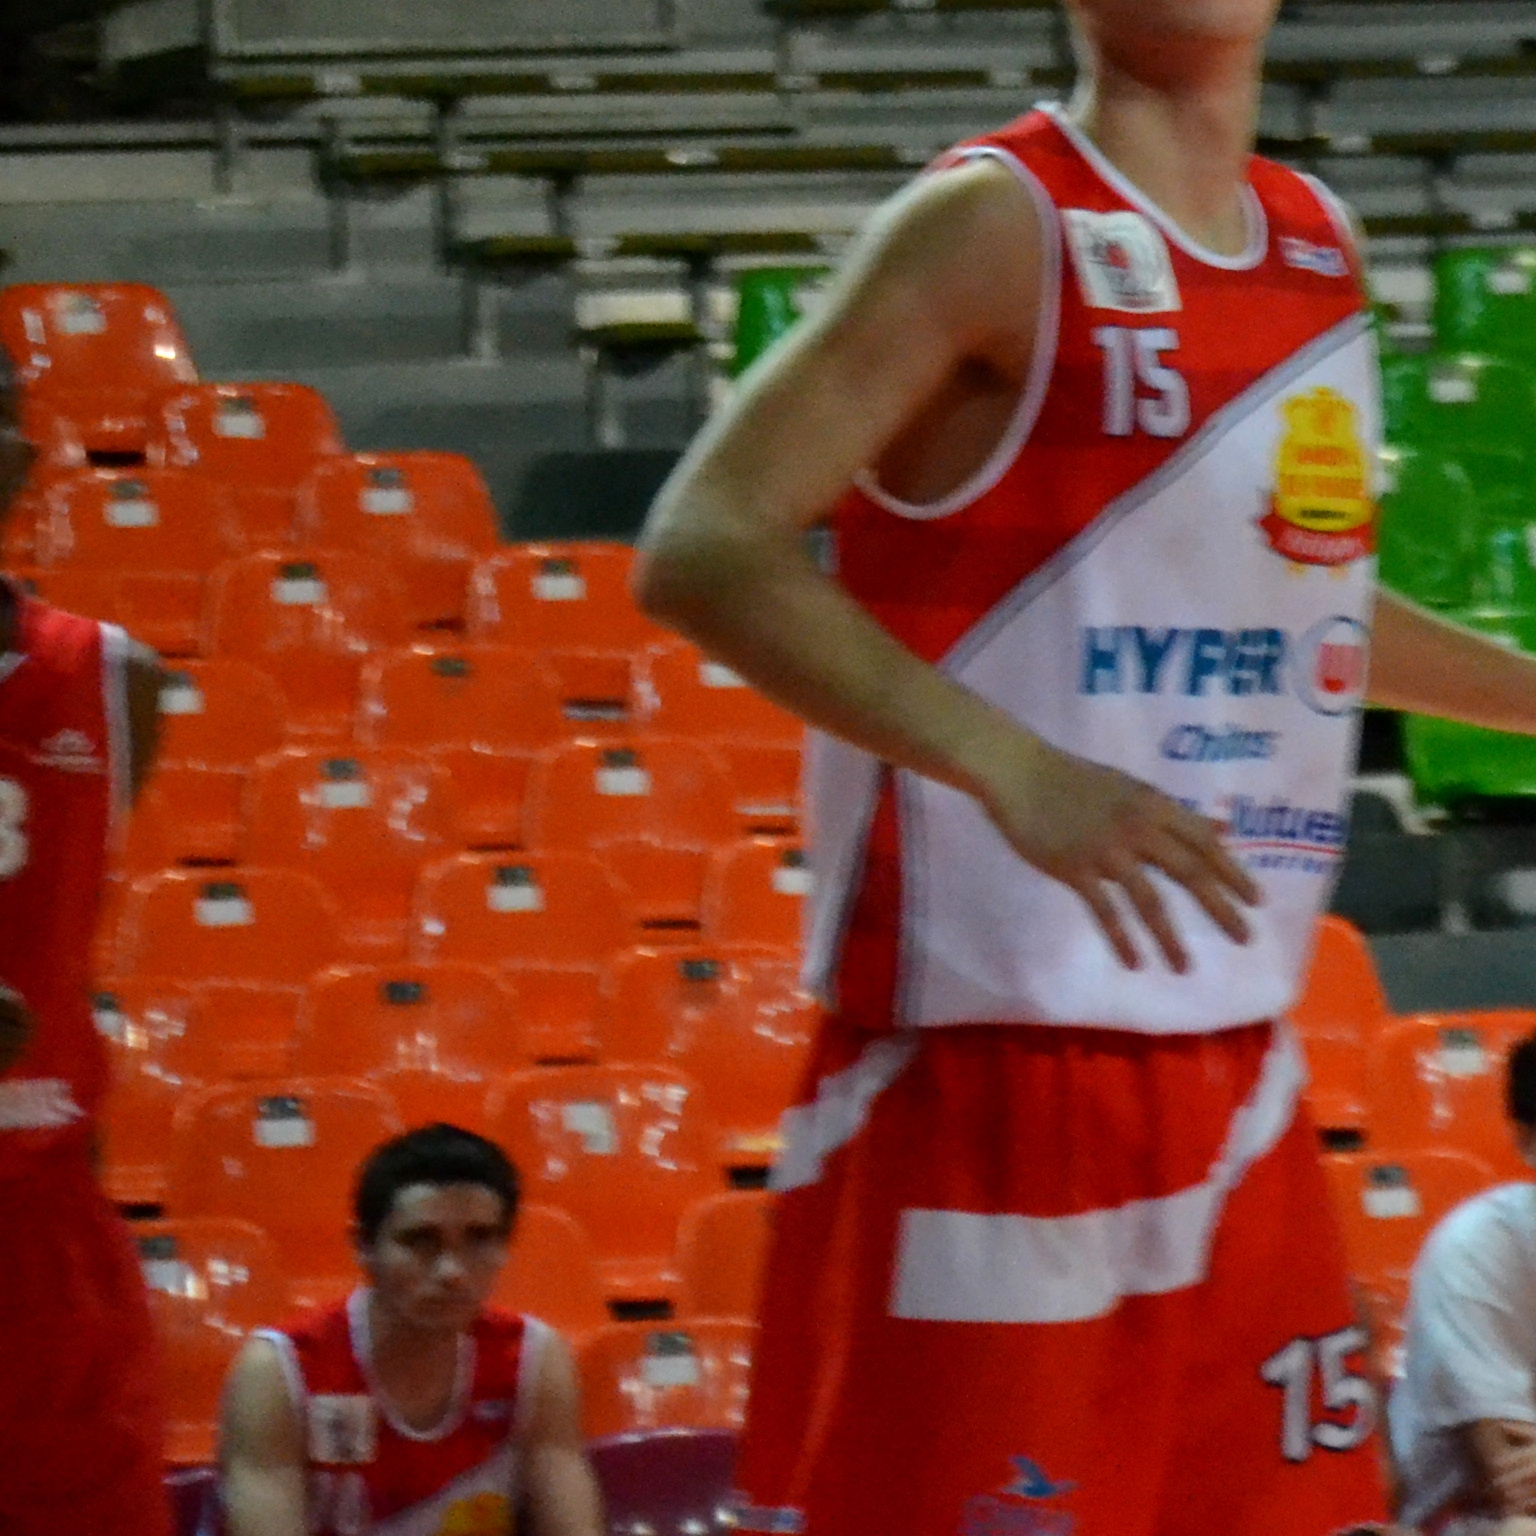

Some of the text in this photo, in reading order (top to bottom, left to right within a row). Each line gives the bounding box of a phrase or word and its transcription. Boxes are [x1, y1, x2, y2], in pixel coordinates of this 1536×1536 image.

[1091, 325, 1192, 439] 15
[1077, 626, 1285, 697] HYPER
[1258, 1325, 1376, 1463] 15
